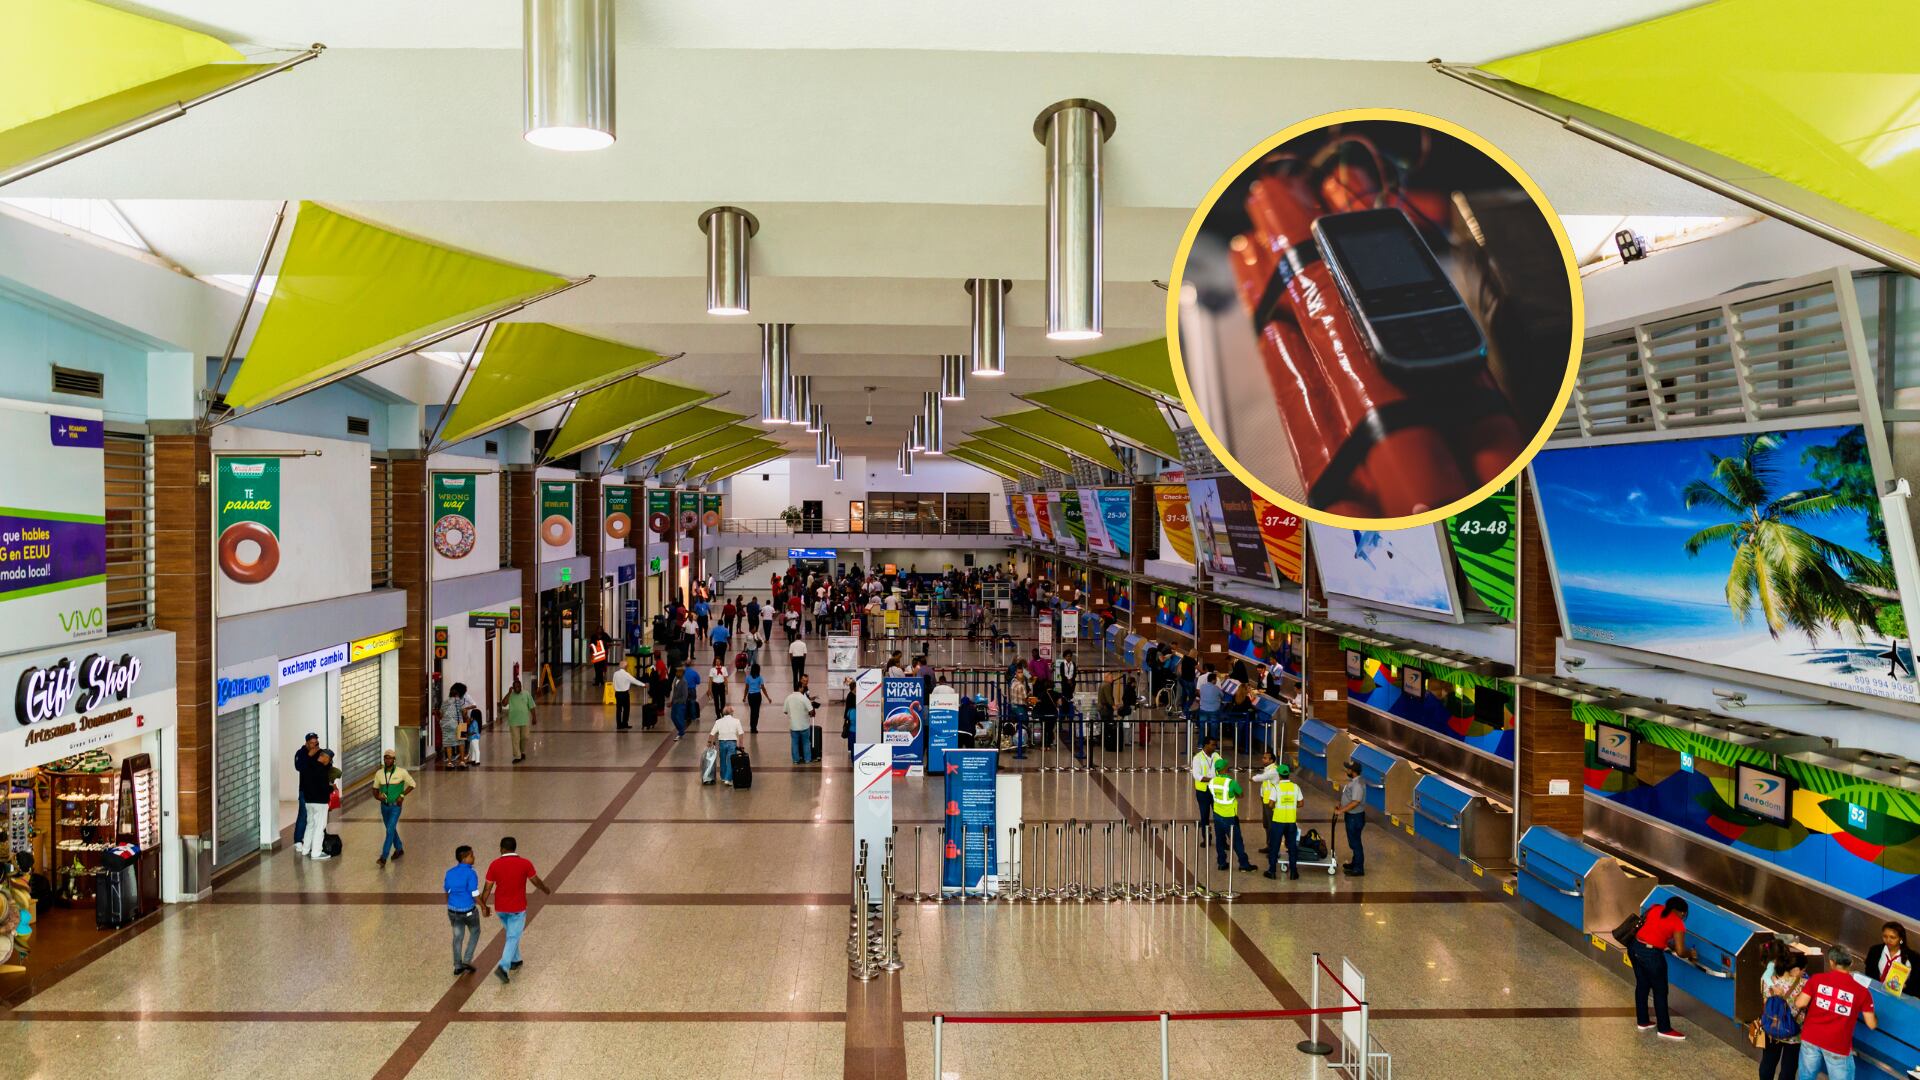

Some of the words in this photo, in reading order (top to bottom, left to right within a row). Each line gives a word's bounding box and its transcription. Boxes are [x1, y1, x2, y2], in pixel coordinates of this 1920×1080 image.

[244, 489, 254, 499] TE
[224, 500, 272, 514] pasaste
[444, 500, 464, 512] way
[1264, 516, 1297, 526] 37-42
[1460, 520, 1507, 534] 43-48
[3, 532, 20, 544] que
[22, 528, 50, 540] hables
[10, 552, 20, 560] en
[24, 544, 50, 560] EEUU
[28, 564, 50, 578] local!
[282, 658, 316, 677] exchange
[320, 650, 344, 668] cambio
[26, 660, 76, 724] Gift
[86, 655, 142, 712] Shop
[1854, 675, 1870, 685] 809
[1872, 678, 1888, 689] 994
[1892, 681, 1914, 694] 9060
[886, 688, 922, 698] MIAMI
[1682, 755, 1692, 768] 50
[1743, 792, 1780, 812] Aerodom
[1850, 806, 1865, 822] 52
